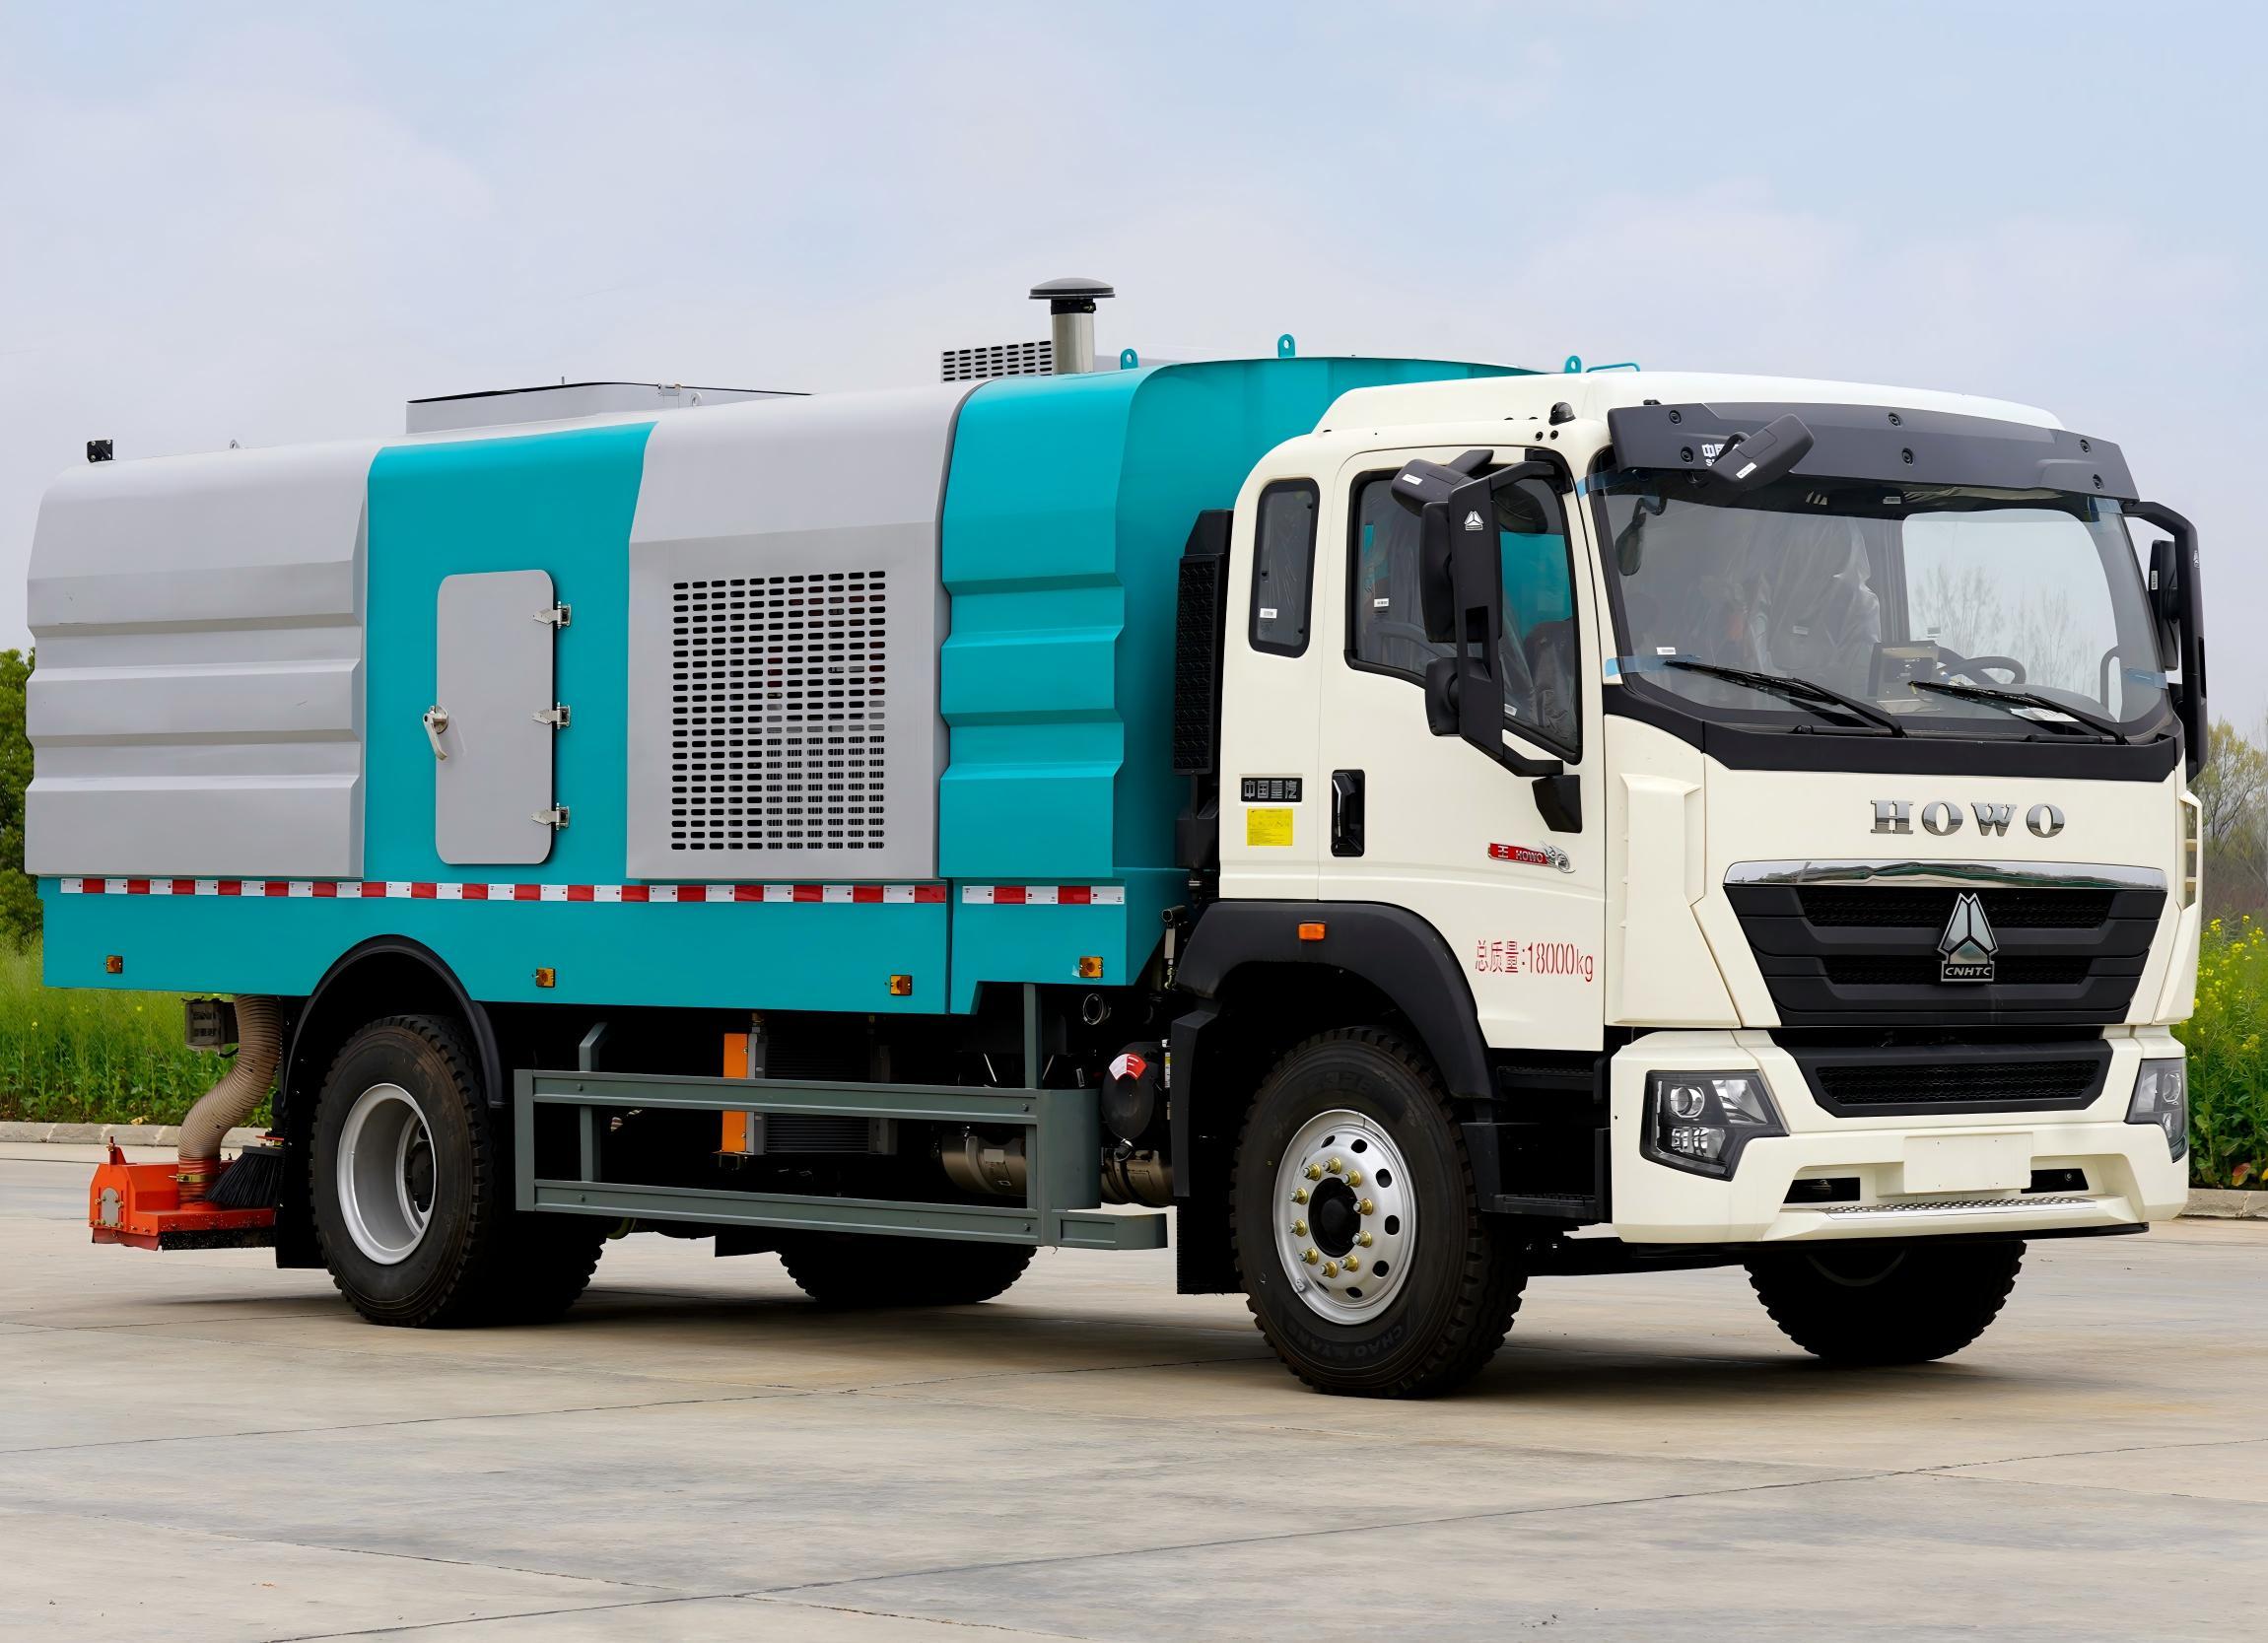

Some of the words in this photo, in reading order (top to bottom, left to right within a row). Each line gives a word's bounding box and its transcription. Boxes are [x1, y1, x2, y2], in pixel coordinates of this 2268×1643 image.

[1244, 780, 1297, 799] 中国重汽
[1870, 799, 2066, 839] HOWO
[1515, 849, 1544, 863] HOWO
[1945, 967, 1992, 976] CNHTC
